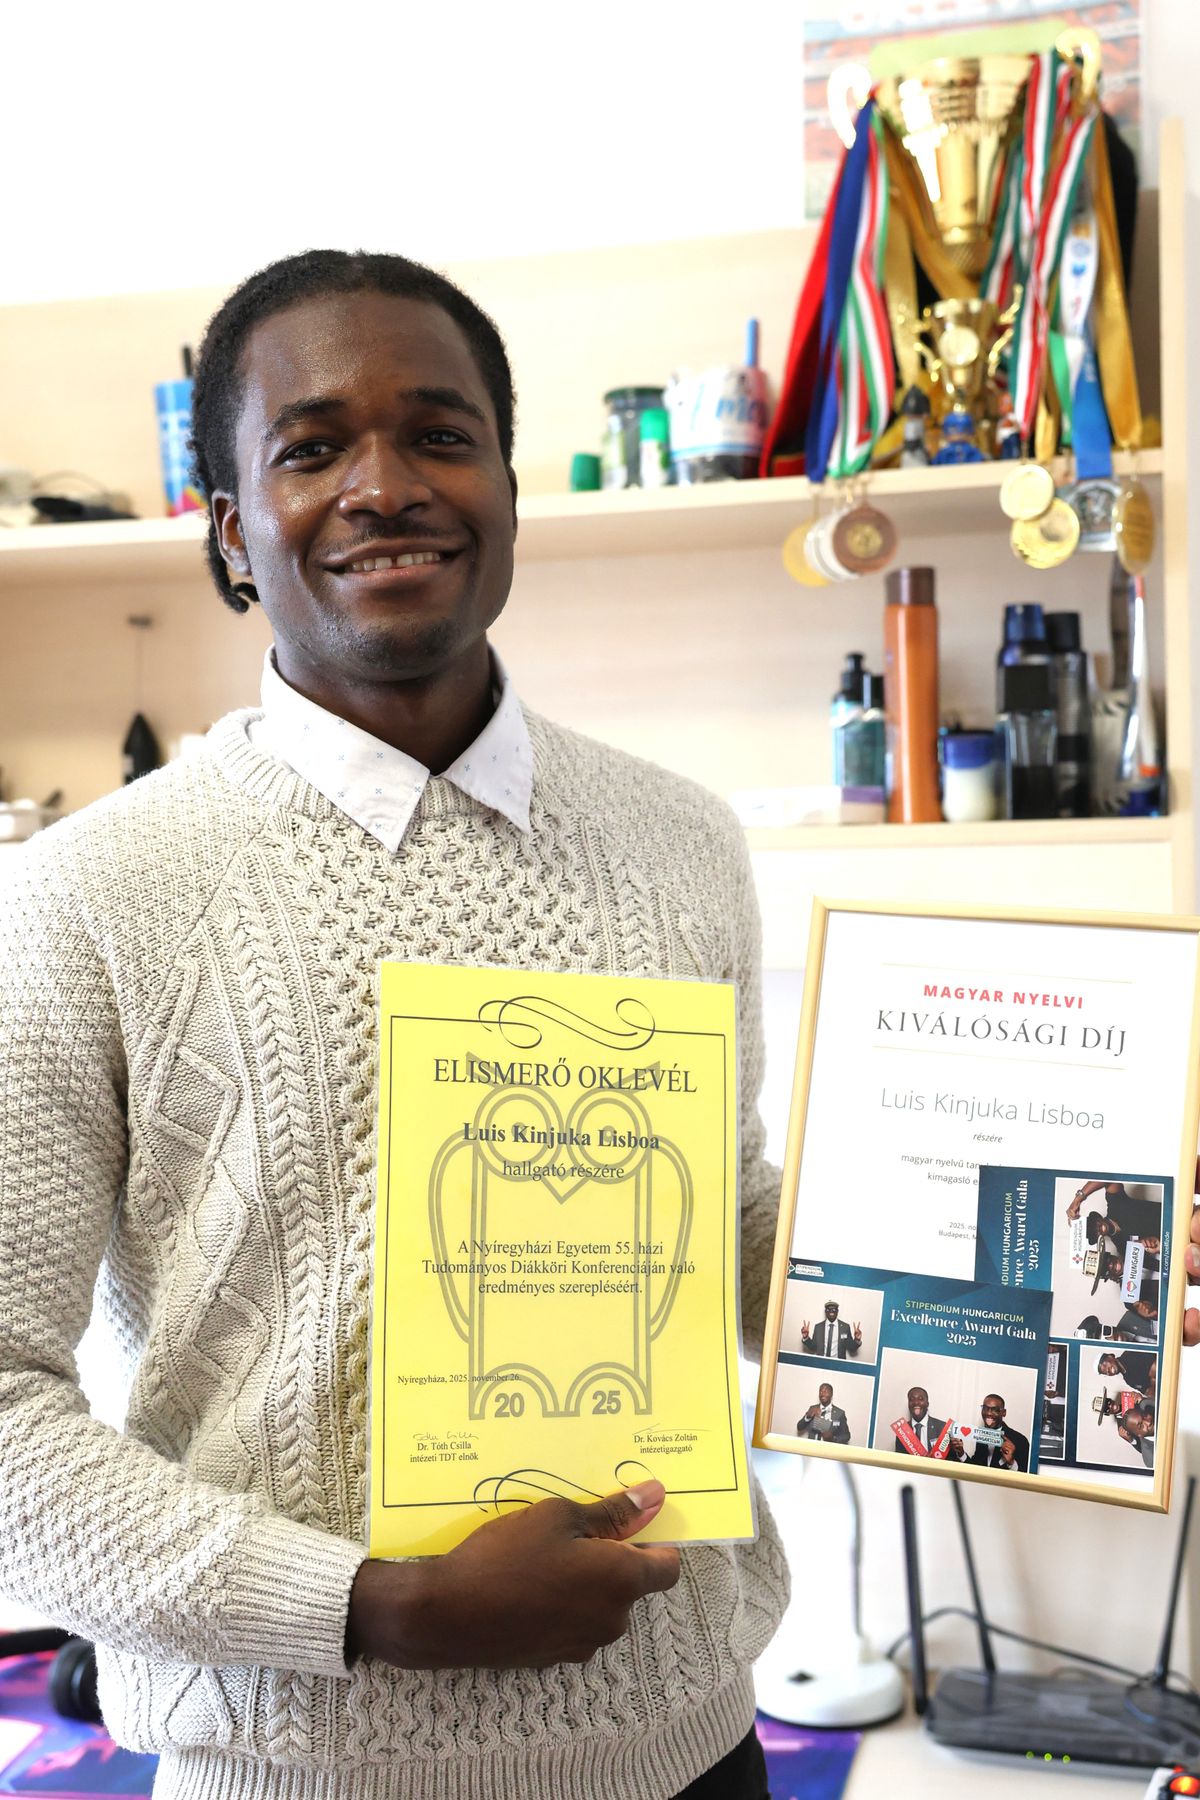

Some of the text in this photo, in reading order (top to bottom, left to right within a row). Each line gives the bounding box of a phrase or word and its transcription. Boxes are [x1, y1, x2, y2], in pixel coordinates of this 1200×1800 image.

[923, 984, 1084, 1009] MAGYAR NYELVI
[876, 1009, 1127, 1057] KIVÁLÓSÁGI DÍJ
[433, 1057, 698, 1093] ELISMERŐ OKLEVÉL
[881, 1087, 1105, 1129] Luis Kinjuka Lisboa
[462, 1122, 661, 1150] Luis Kinjuka Lisboa
[972, 1132, 1003, 1144] részére
[502, 1160, 625, 1182] hallgató részére
[901, 1153, 934, 1167] magyar
[935, 1156, 964, 1170] nyelvű
[927, 1172, 970, 1185] kimagasló
[1015, 1180, 1028, 1210] Gala
[1002, 1192, 1012, 1255] HUNGARICUM
[1014, 1213, 1026, 1257] Award
[457, 1240, 664, 1259] A Nyíregyházi Egyetem 55. házi
[1027, 1239, 1040, 1271] 2025
[422, 1259, 696, 1279] Tudományos Diákköri Konferenciáján való
[1129, 1246, 1139, 1280] HUNGARY
[478, 1279, 643, 1296] eredményes szerepléséért.
[905, 1300, 1024, 1324] STIPENDIUM HUNGARICUM
[890, 1309, 1037, 1341] Excellence Award Gala
[946, 1332, 977, 1347] 2025
[397, 1375, 448, 1386] Nyíregyháza,
[449, 1374, 470, 1383] 2025.
[471, 1374, 509, 1383] november
[494, 1390, 622, 1418] 20 25
[417, 1441, 471, 1451] Dr. Tóth Csilla
[633, 1433, 698, 1444] Dr. Kovács Zoltán
[640, 1444, 693, 1455] intézetigazgató
[410, 1453, 437, 1463] intézeti
[438, 1453, 457, 1462] TDT
